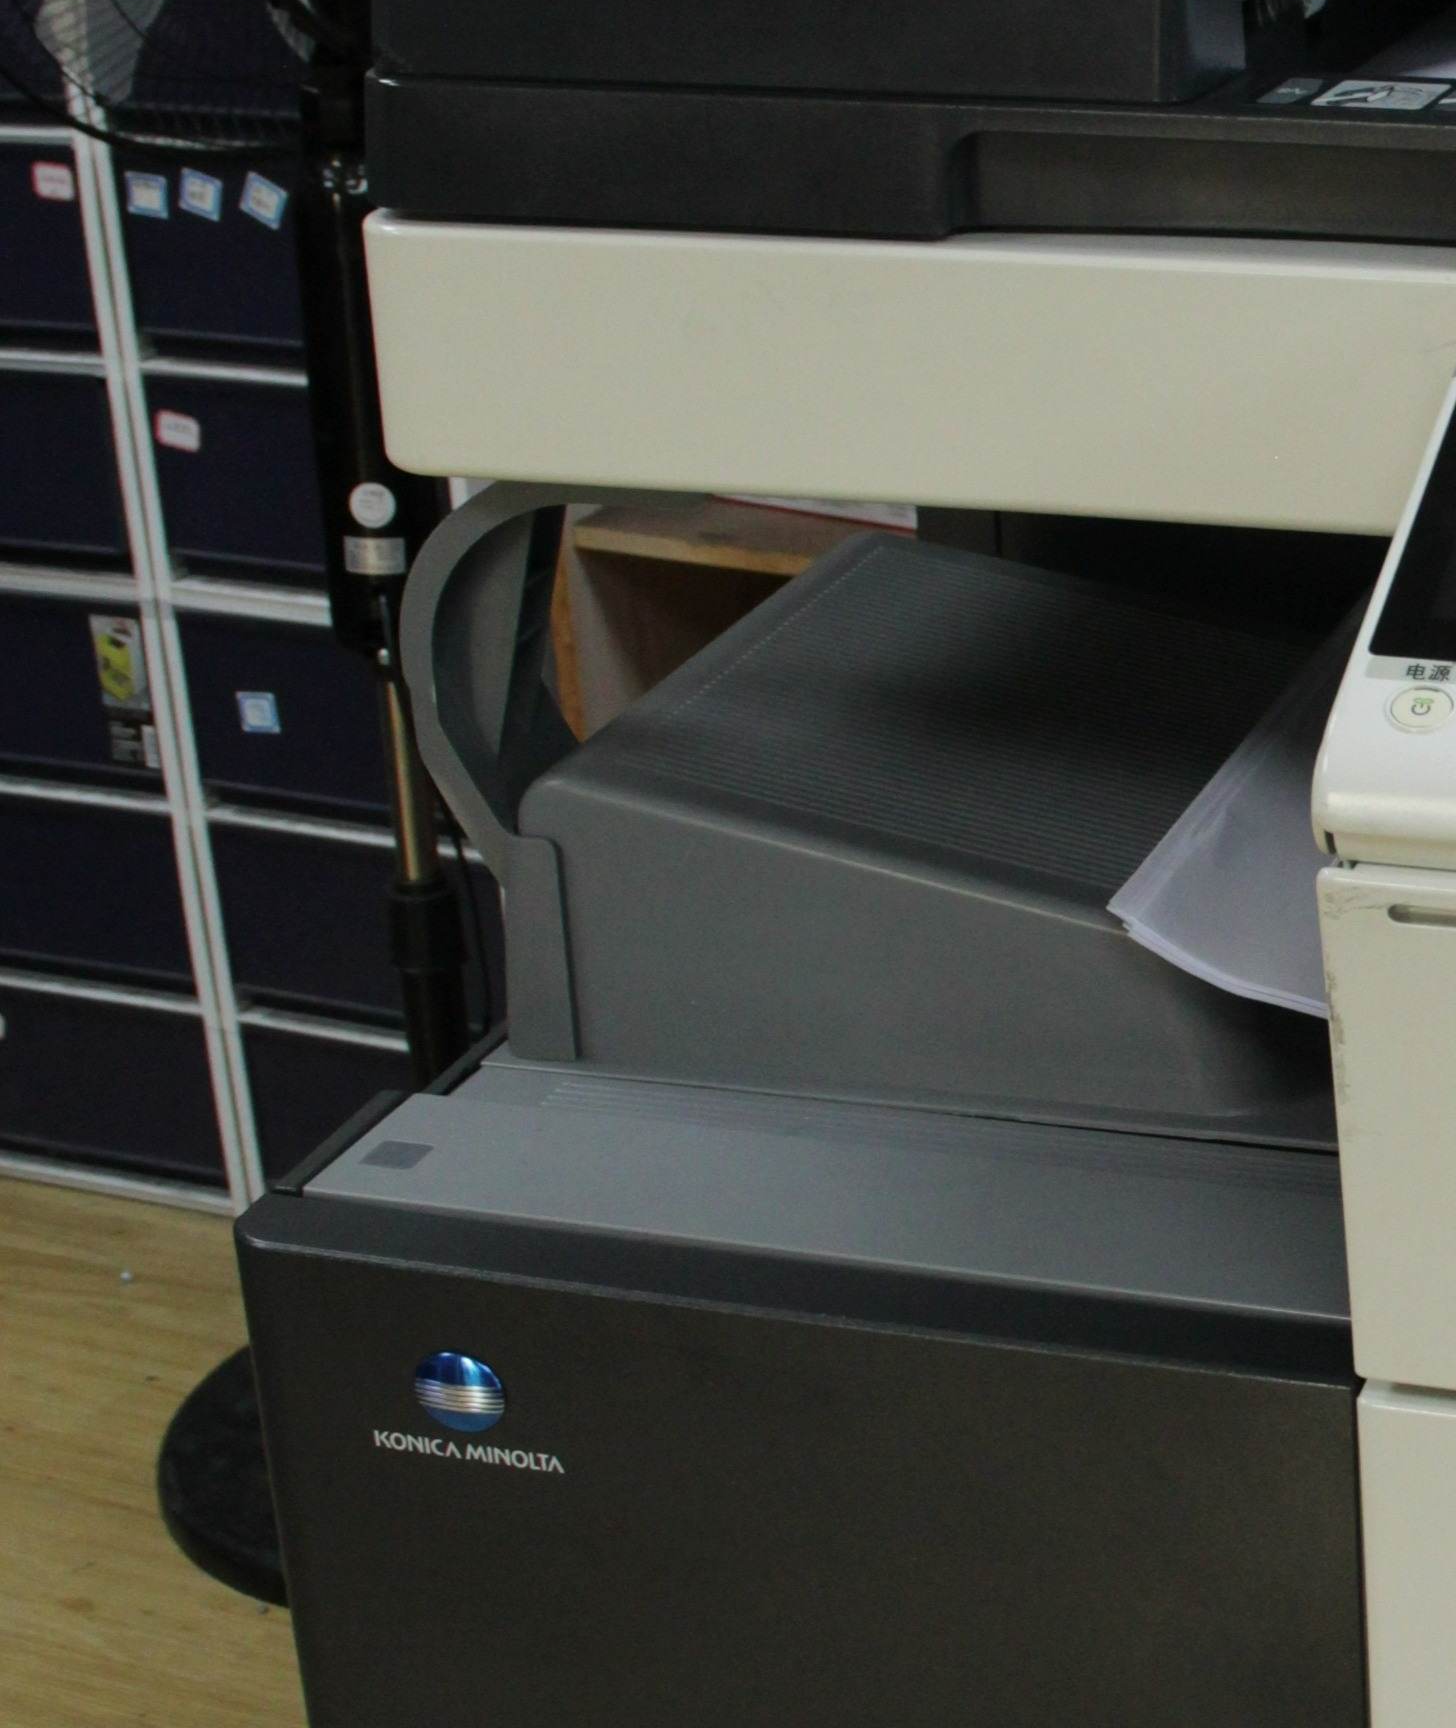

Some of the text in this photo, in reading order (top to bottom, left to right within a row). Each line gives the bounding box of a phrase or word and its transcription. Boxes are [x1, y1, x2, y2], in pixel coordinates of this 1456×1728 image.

[1406, 663, 1452, 683] 电源
[373, 1429, 565, 1474] KONICA MINOLTA
